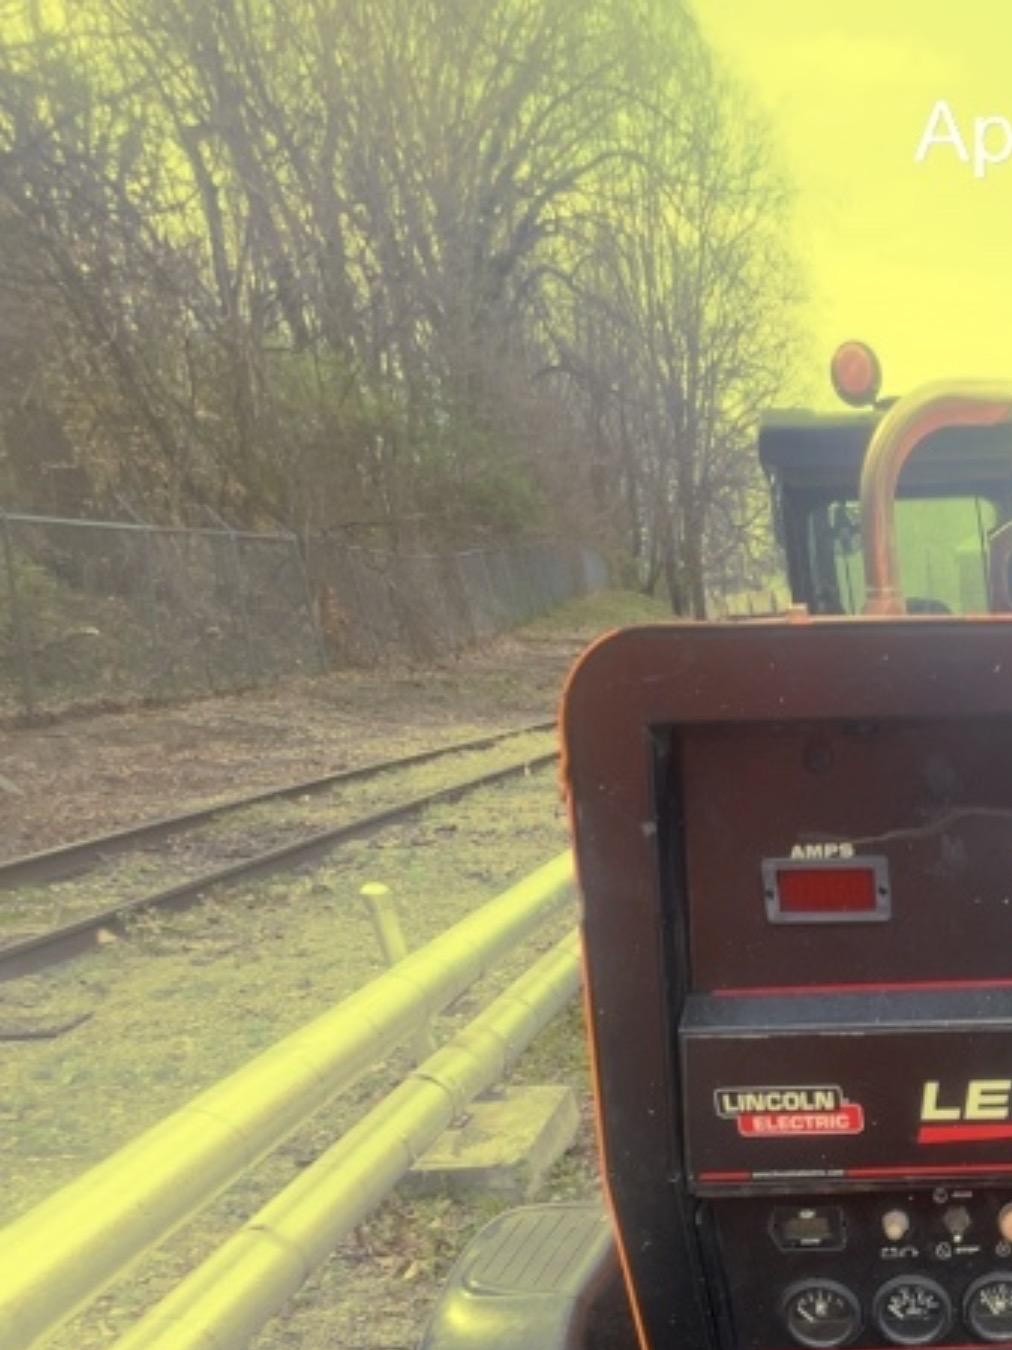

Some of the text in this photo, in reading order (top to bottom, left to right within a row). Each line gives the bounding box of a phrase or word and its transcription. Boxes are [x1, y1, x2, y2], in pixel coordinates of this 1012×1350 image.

[791, 842, 856, 859] AMPS
[721, 1089, 835, 1113] LINCOLN
[752, 1114, 850, 1132] ELECTRIC
